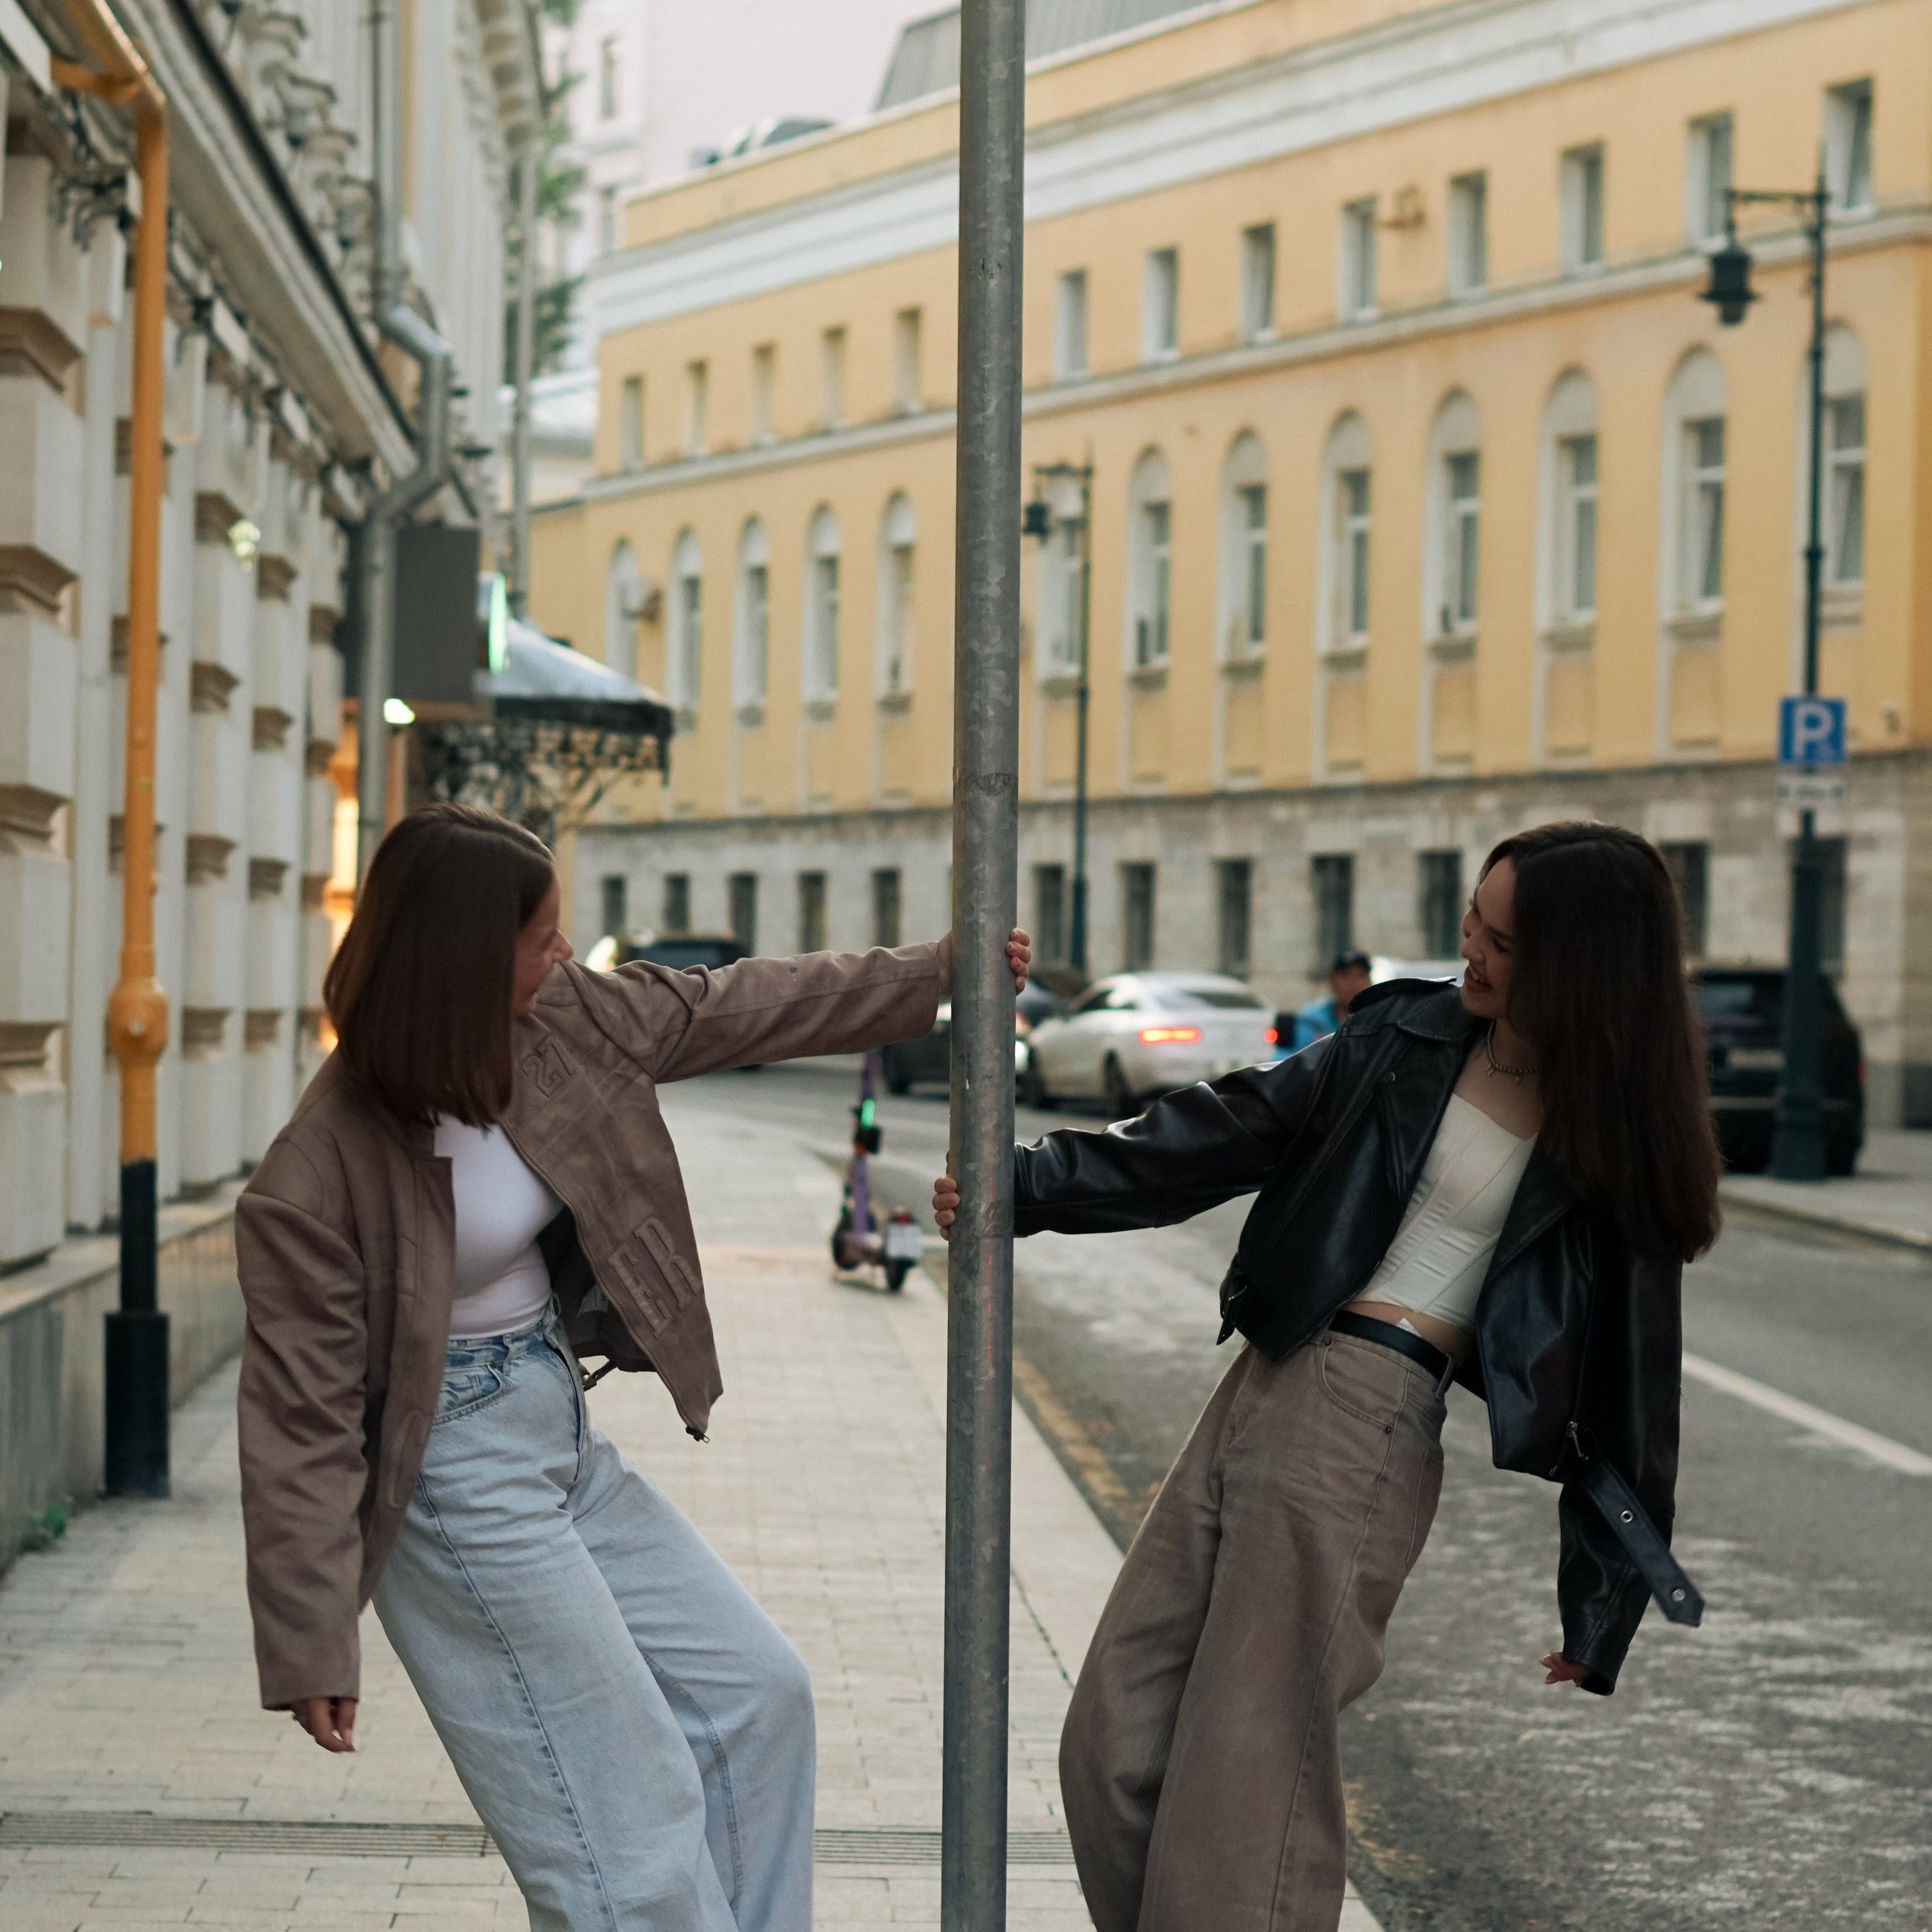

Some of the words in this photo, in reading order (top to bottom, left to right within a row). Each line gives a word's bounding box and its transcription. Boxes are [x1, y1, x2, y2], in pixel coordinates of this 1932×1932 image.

[1793, 703, 1835, 757] P
[521, 1034, 577, 1099] 27
[608, 1217, 703, 1339] ER
